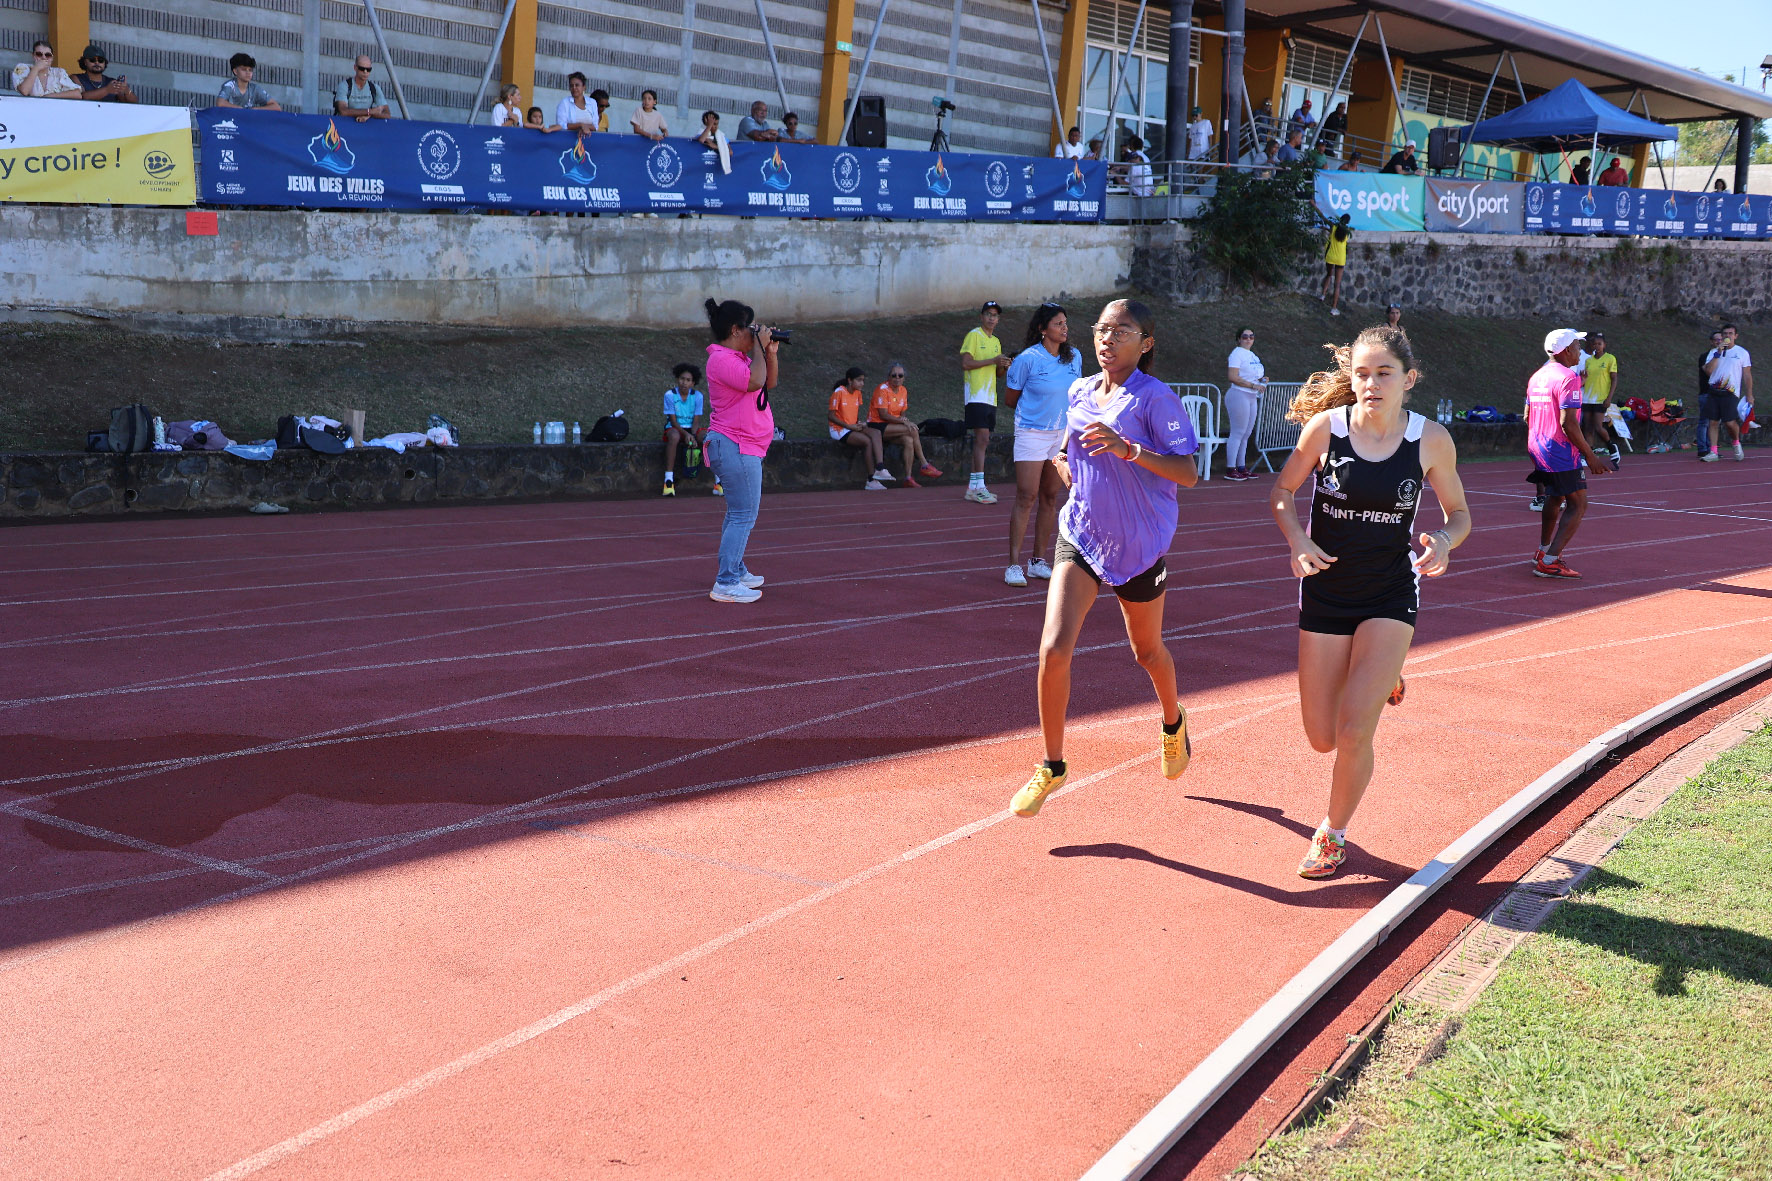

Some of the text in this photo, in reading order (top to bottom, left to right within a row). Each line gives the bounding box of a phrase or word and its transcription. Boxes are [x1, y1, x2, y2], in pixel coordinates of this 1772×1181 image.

[24, 147, 107, 173] croire
[116, 147, 121, 168] !
[288, 175, 385, 195] JEUX DES VILLES
[543, 186, 620, 202] JEUX DES VILLES
[748, 192, 810, 206] JEUX DES VILLES
[1328, 182, 1410, 218] be sport
[914, 196, 966, 210] JEUX DES VILLES
[1054, 200, 1099, 212] JEUX DES VILLES
[1572, 217, 1603, 227] JEUX DES VILLES
[1322, 502, 1404, 524] SAINT-PIERRE
